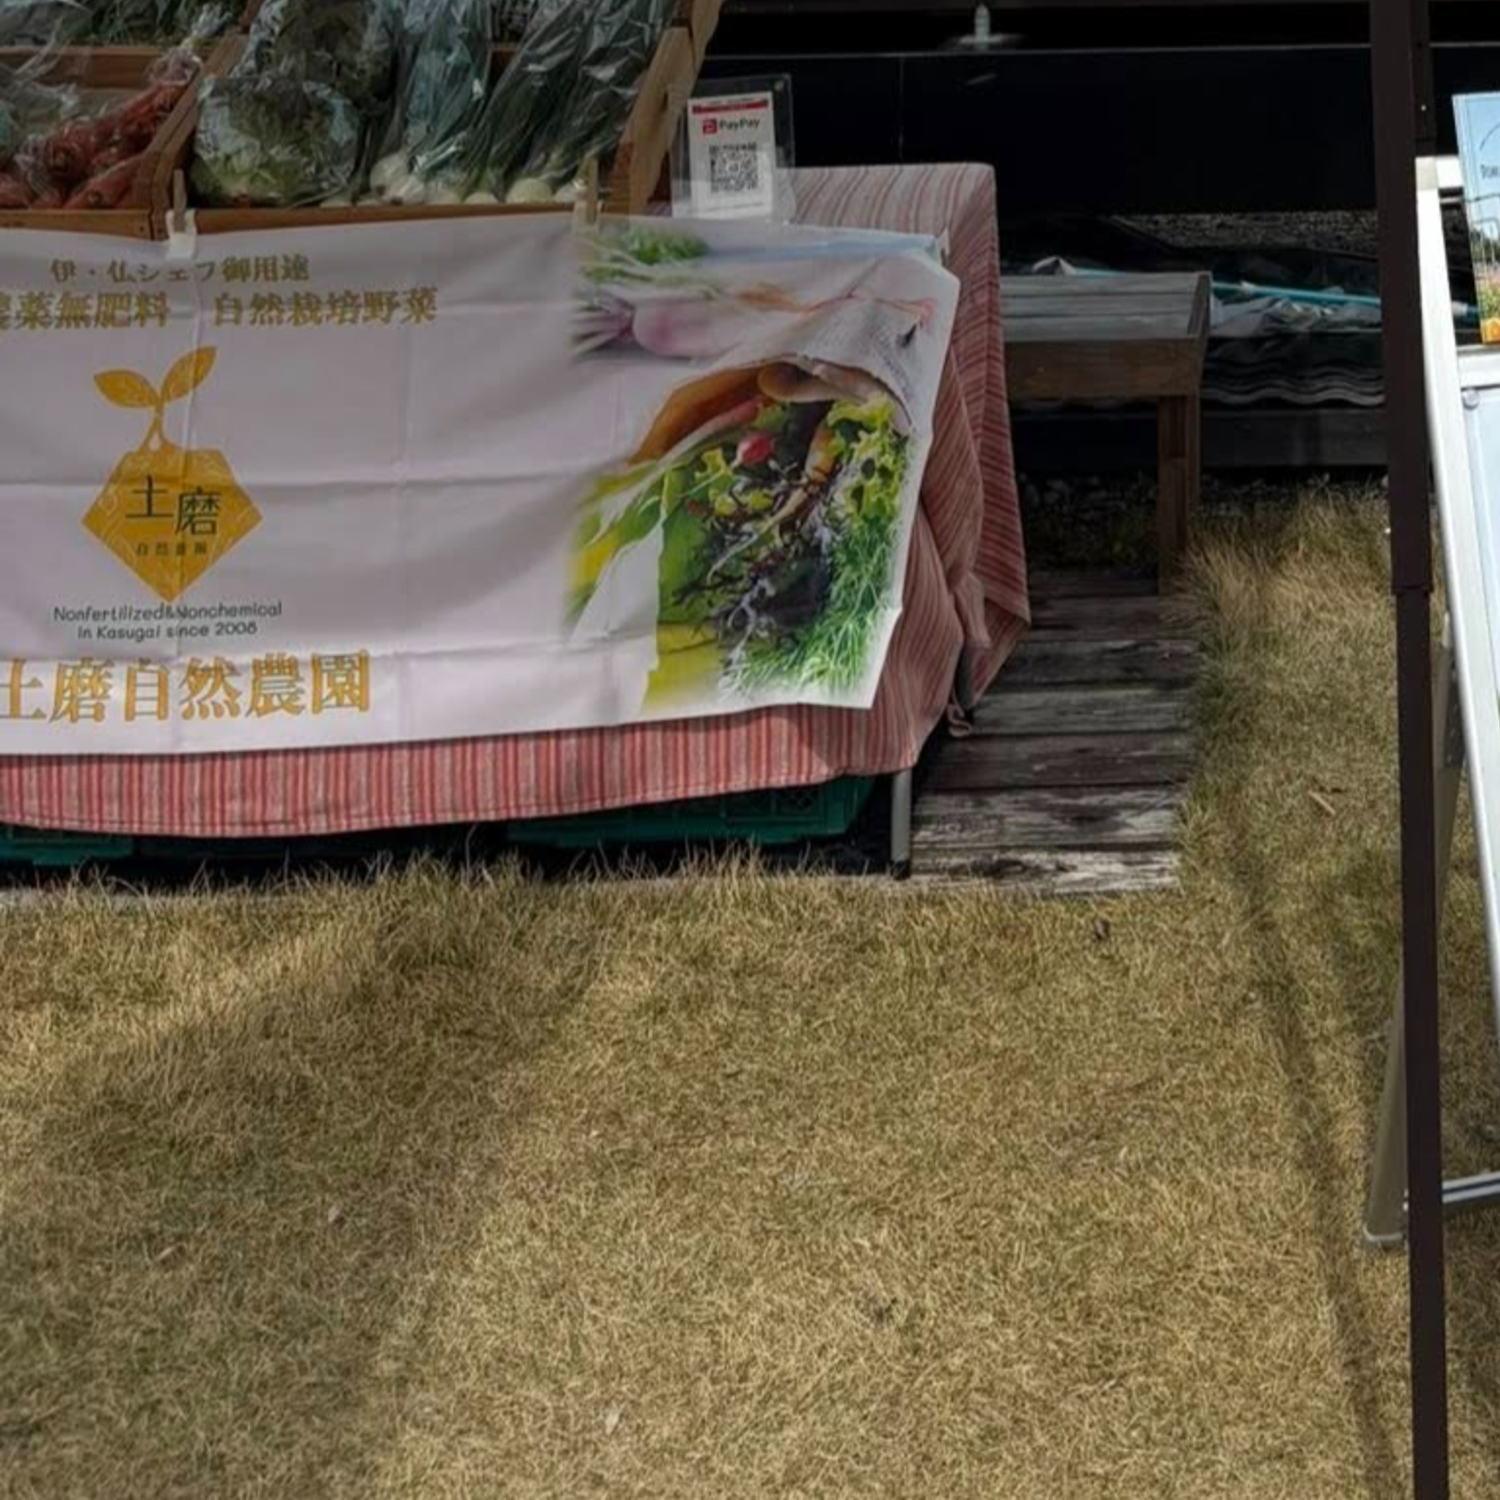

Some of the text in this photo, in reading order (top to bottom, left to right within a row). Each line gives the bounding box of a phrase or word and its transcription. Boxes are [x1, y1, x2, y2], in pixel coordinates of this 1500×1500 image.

[719, 117, 760, 132] PayPay
[213, 285, 438, 327] 自然栽培野菜
[96, 624, 161, 643] Kasugai
[166, 623, 210, 638] since
